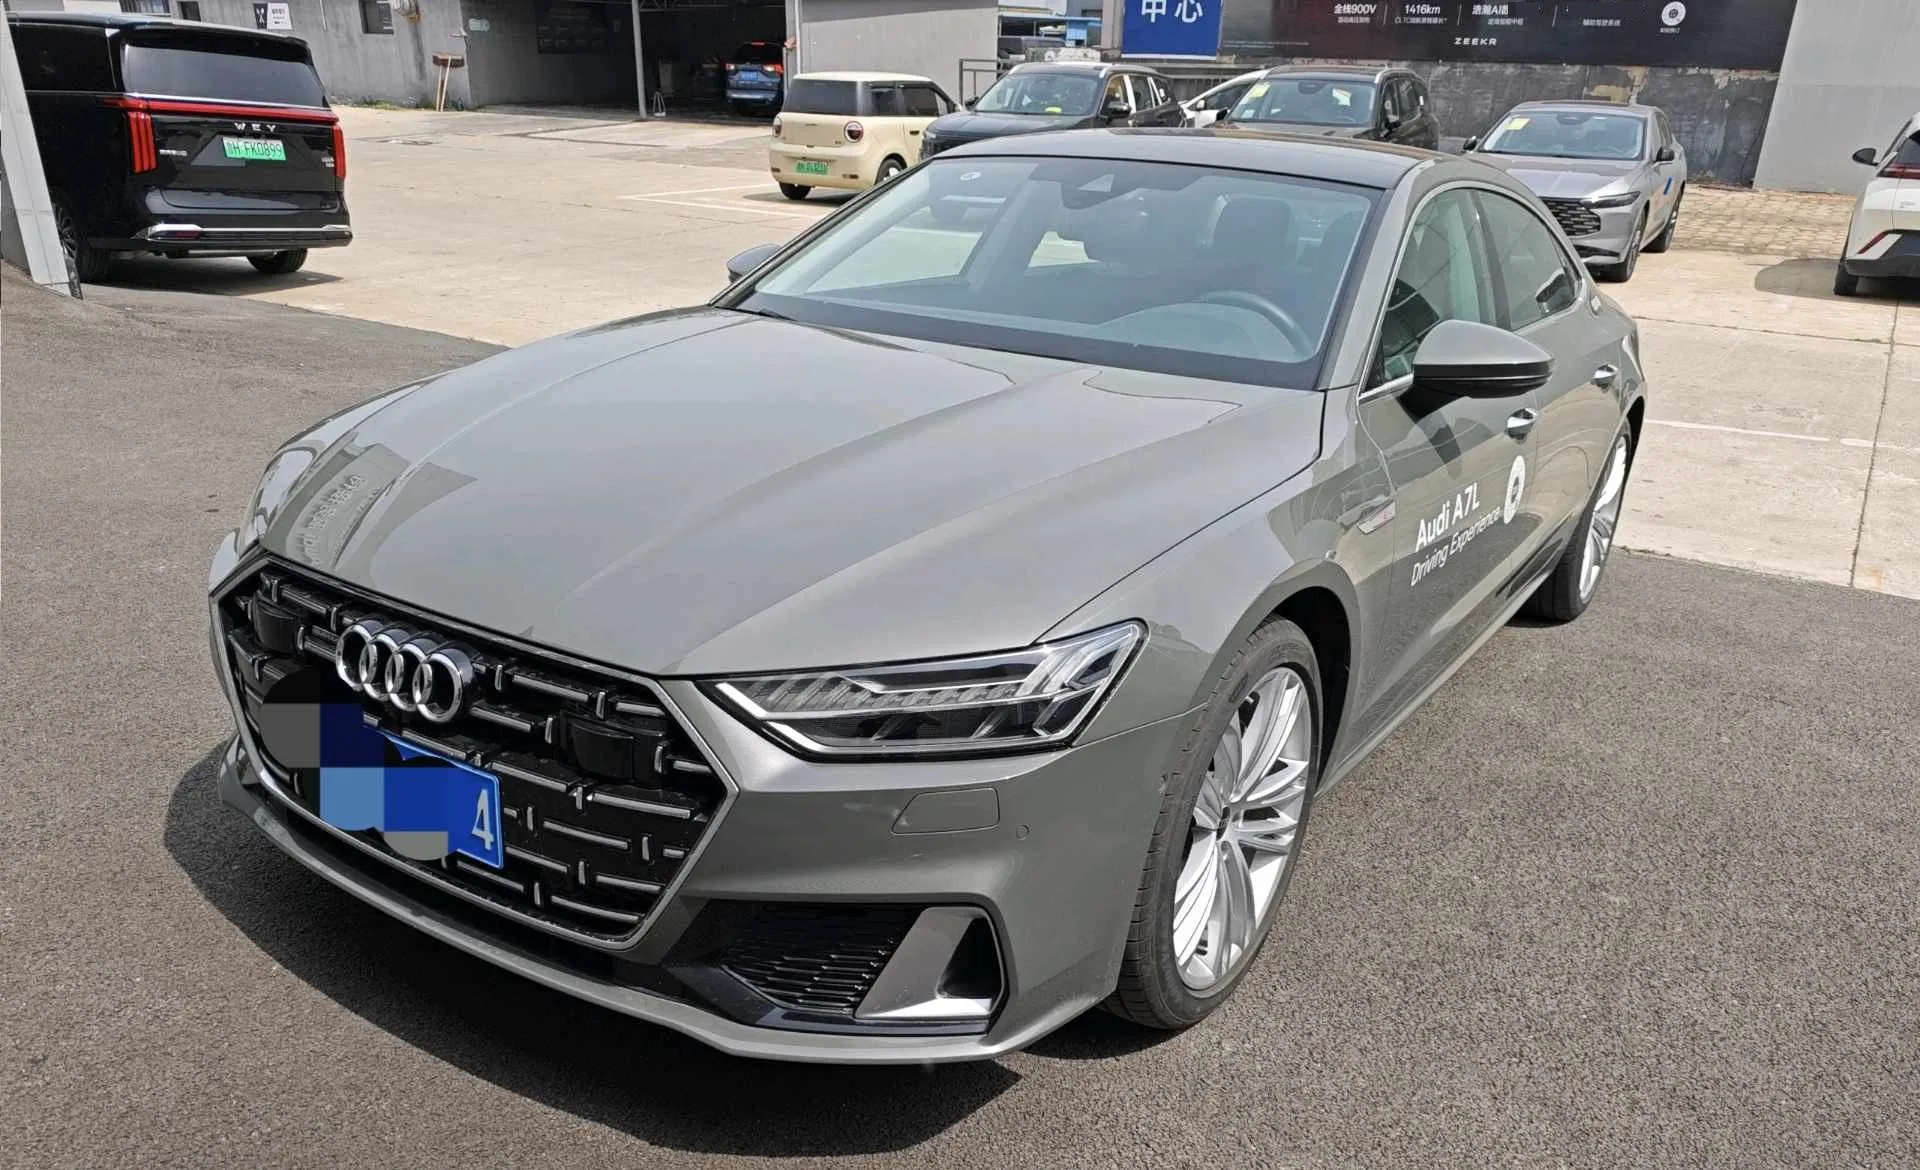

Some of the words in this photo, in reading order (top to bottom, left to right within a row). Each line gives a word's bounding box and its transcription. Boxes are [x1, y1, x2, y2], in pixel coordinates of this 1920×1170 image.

[1405, 4, 1441, 15] 1416km
[1454, 37, 1497, 46] ZEEKR
[234, 122, 276, 132] WEY
[1415, 500, 1451, 553] Audi
[1451, 482, 1480, 525] A7L
[1410, 544, 1450, 587] Driving
[1449, 506, 1502, 556] Experience
[471, 788, 494, 851] 4
